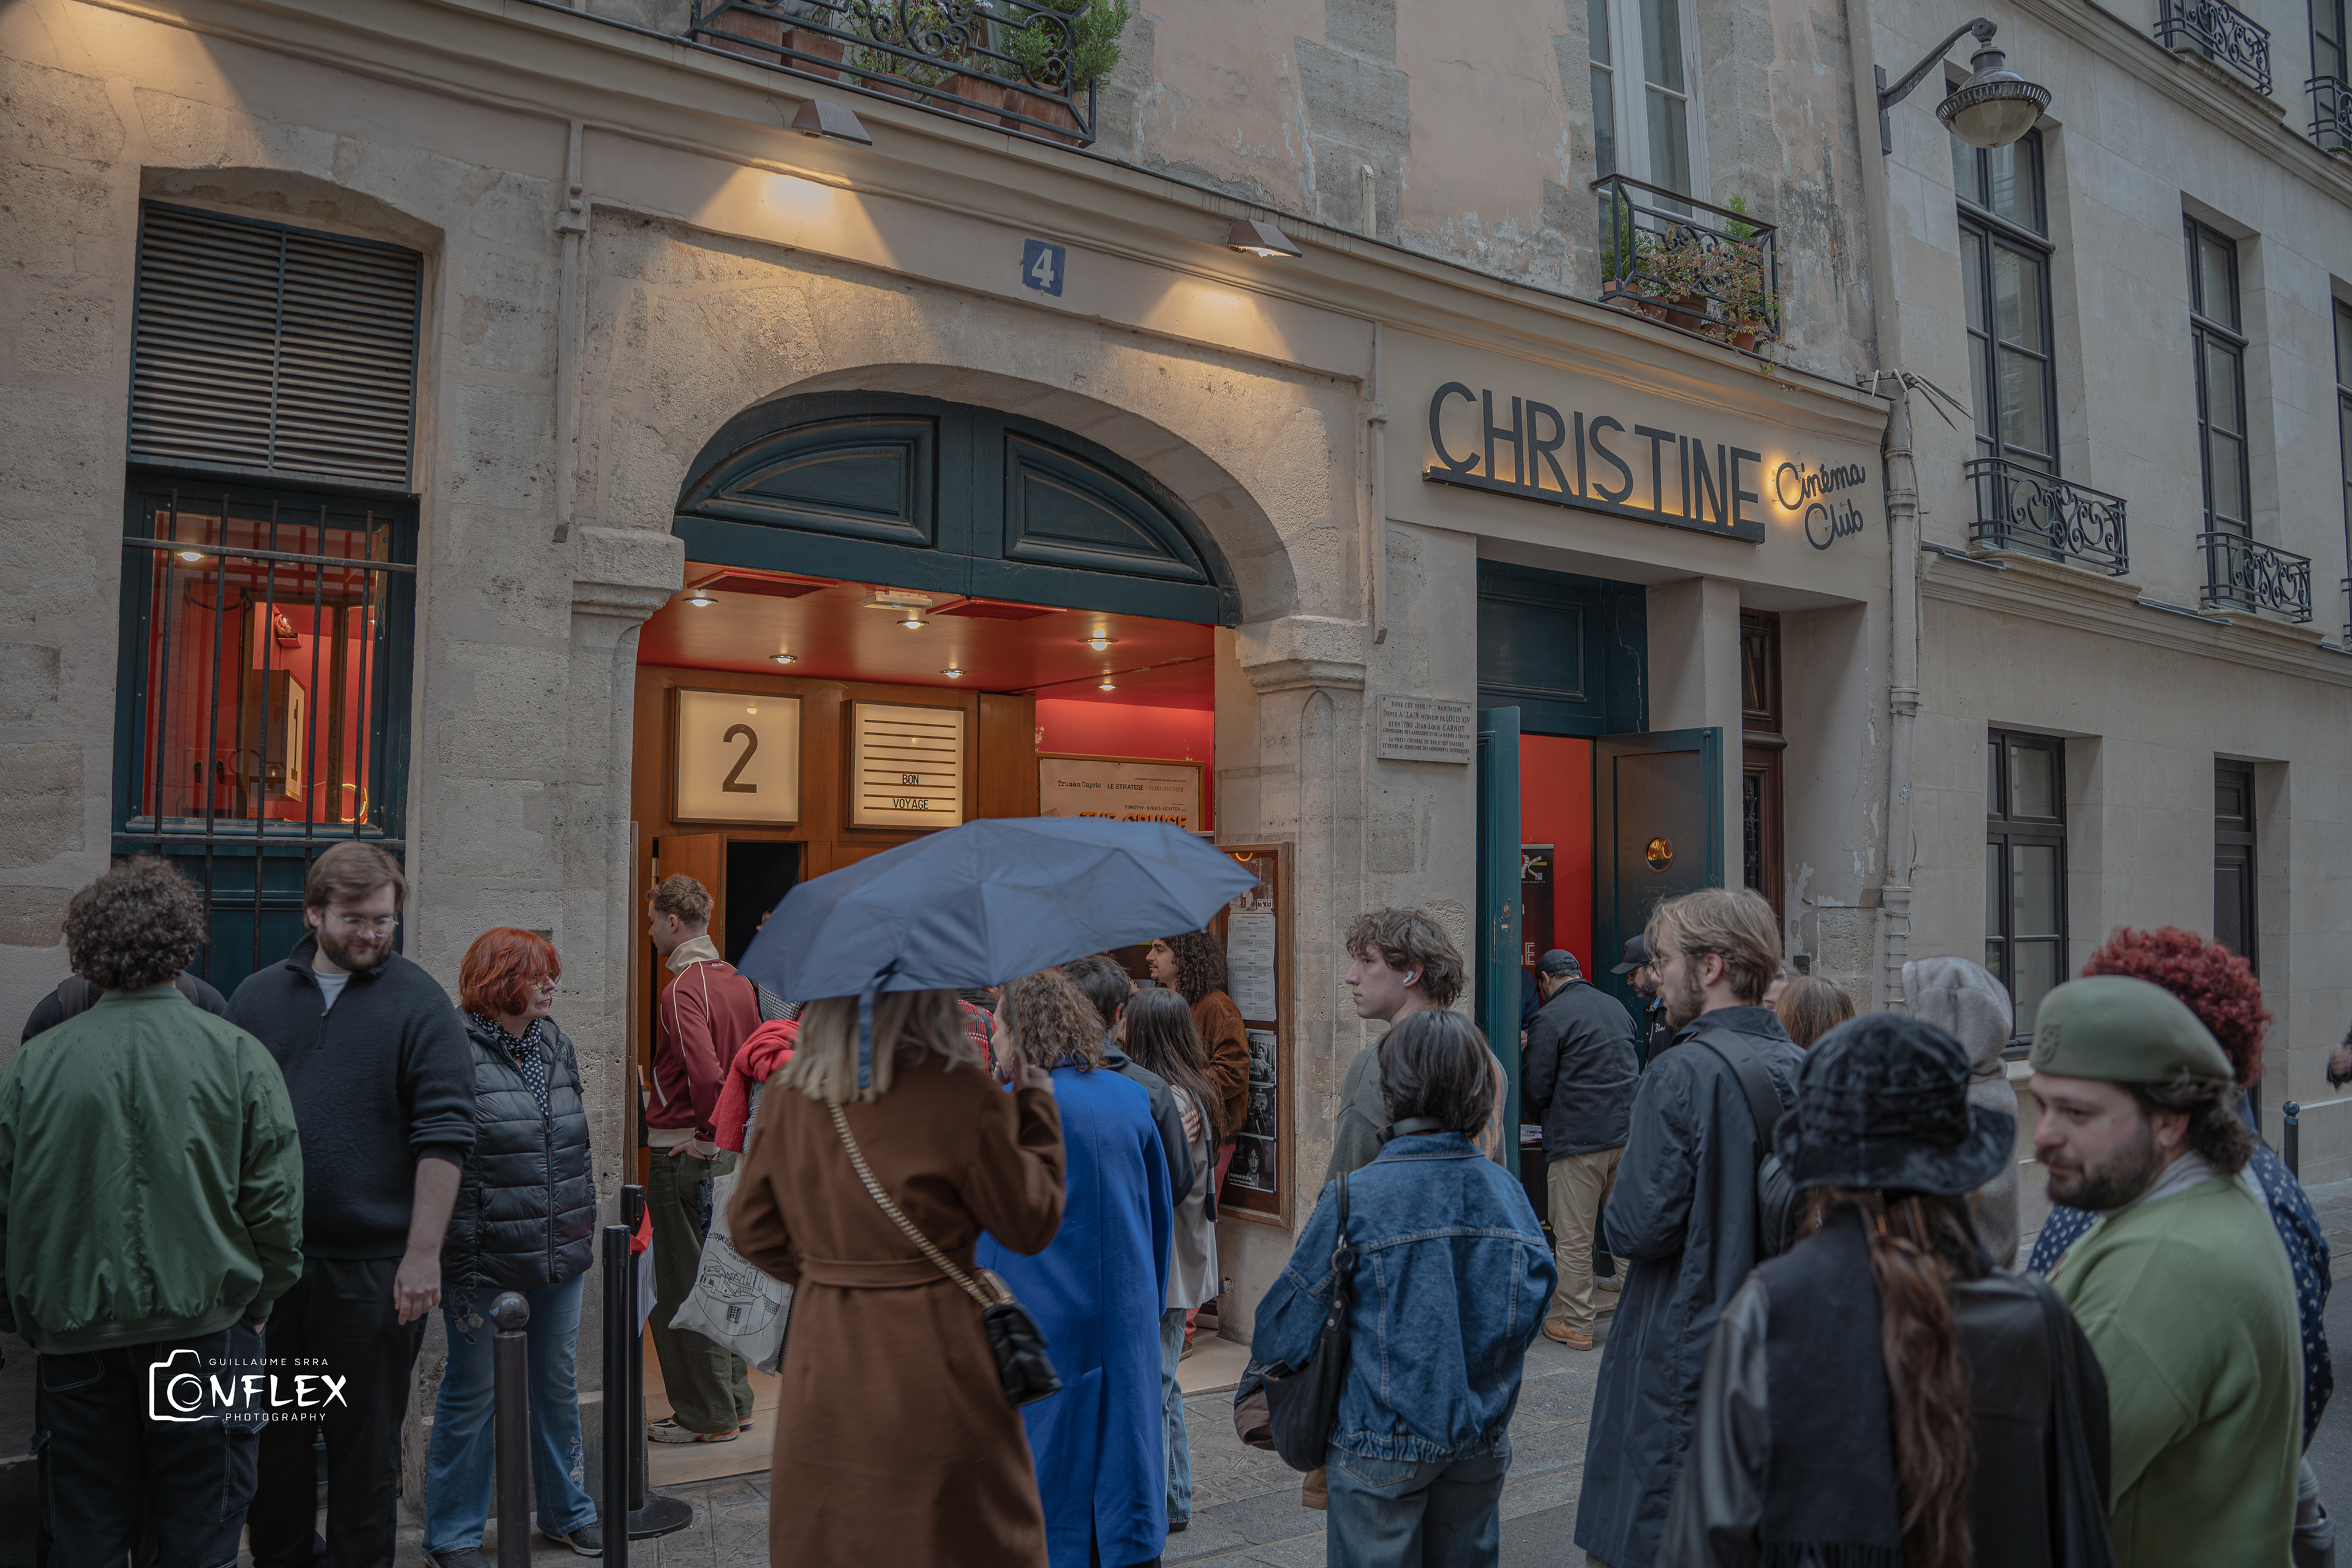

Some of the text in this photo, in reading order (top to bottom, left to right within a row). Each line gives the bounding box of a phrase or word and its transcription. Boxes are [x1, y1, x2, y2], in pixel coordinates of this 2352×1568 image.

[1031, 248, 1054, 288] 4
[1429, 381, 1762, 528] CHRISTINE
[1776, 461, 1866, 511] Cinéma
[1804, 499, 1863, 551] Club
[722, 723, 758, 793] 2
[902, 774, 919, 785] BON
[893, 798, 929, 810] VOYAGE
[1058, 780, 1081, 788] Truman
[1082, 781, 1101, 790] Capote
